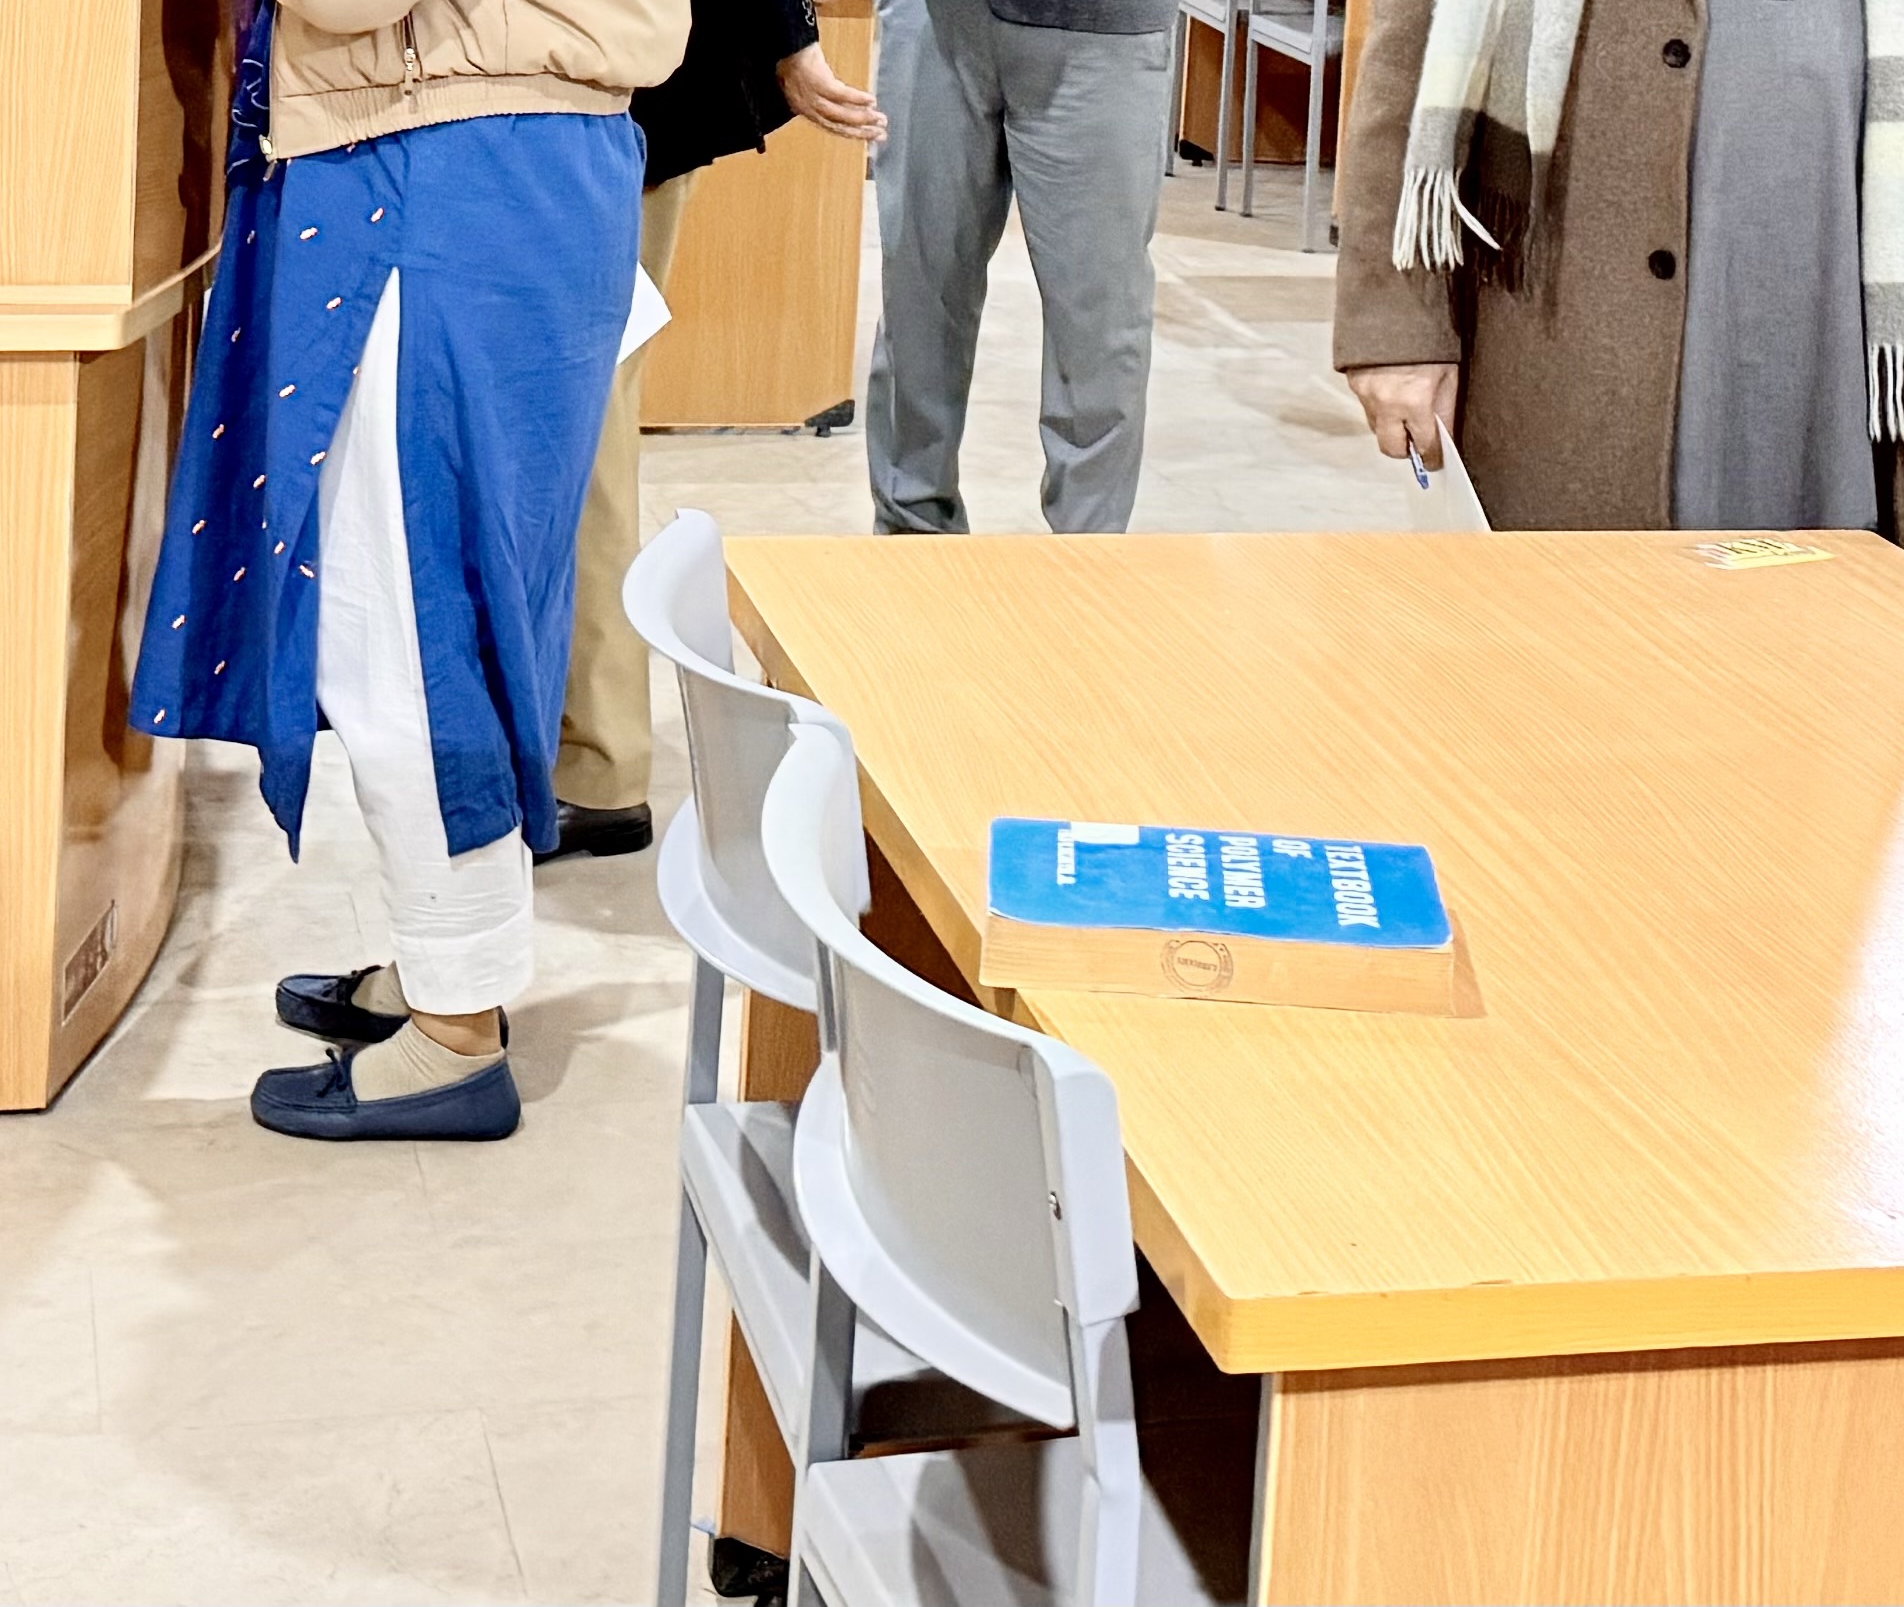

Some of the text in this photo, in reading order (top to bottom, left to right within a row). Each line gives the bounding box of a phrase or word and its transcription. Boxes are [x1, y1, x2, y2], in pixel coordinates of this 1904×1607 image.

[1165, 833, 1210, 901] SCIENCE
[1218, 835, 1266, 909] POLYMER
[1272, 838, 1313, 859] OF
[1324, 845, 1381, 928] TEXTBOOK
